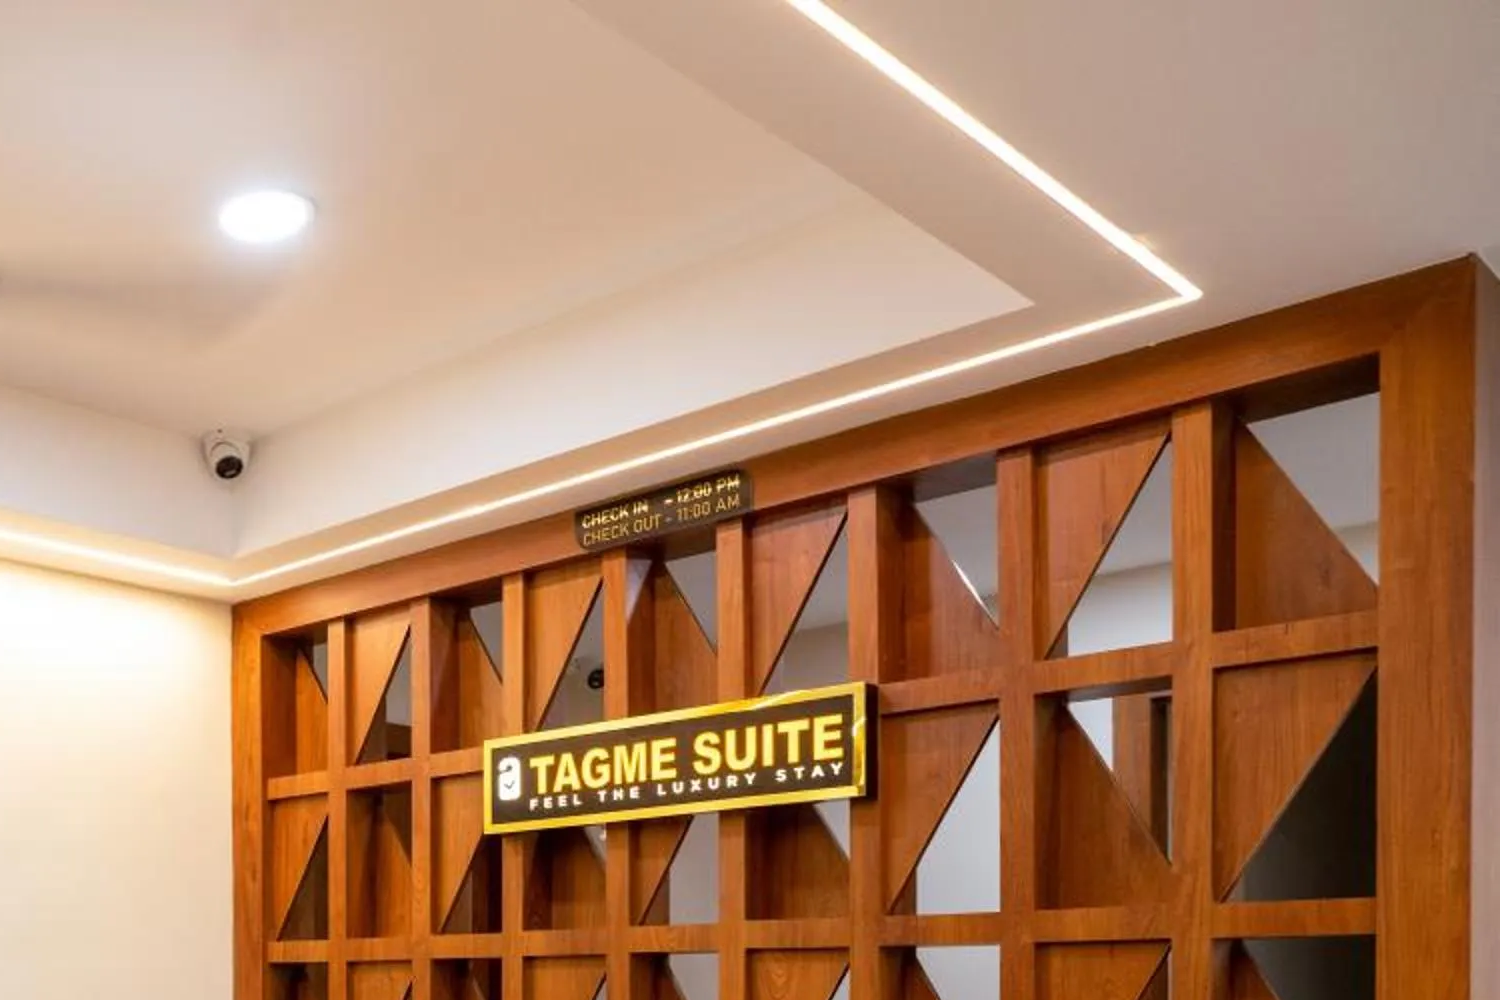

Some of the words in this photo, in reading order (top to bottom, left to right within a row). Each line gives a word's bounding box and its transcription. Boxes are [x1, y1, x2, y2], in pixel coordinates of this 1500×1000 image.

[582, 504, 629, 528] CHECK
[633, 500, 649, 515] IN
[716, 473, 741, 493] PM
[583, 524, 629, 546] CHECK
[633, 513, 662, 533] OUT
[676, 502, 711, 522] 11:00
[715, 494, 741, 513] AM
[530, 738, 678, 794] TAGME
[692, 714, 844, 776] SUITE
[529, 794, 583, 811] FEEL
[597, 786, 640, 803] THE
[657, 774, 757, 796] LUXURY
[775, 762, 845, 783] STAY
